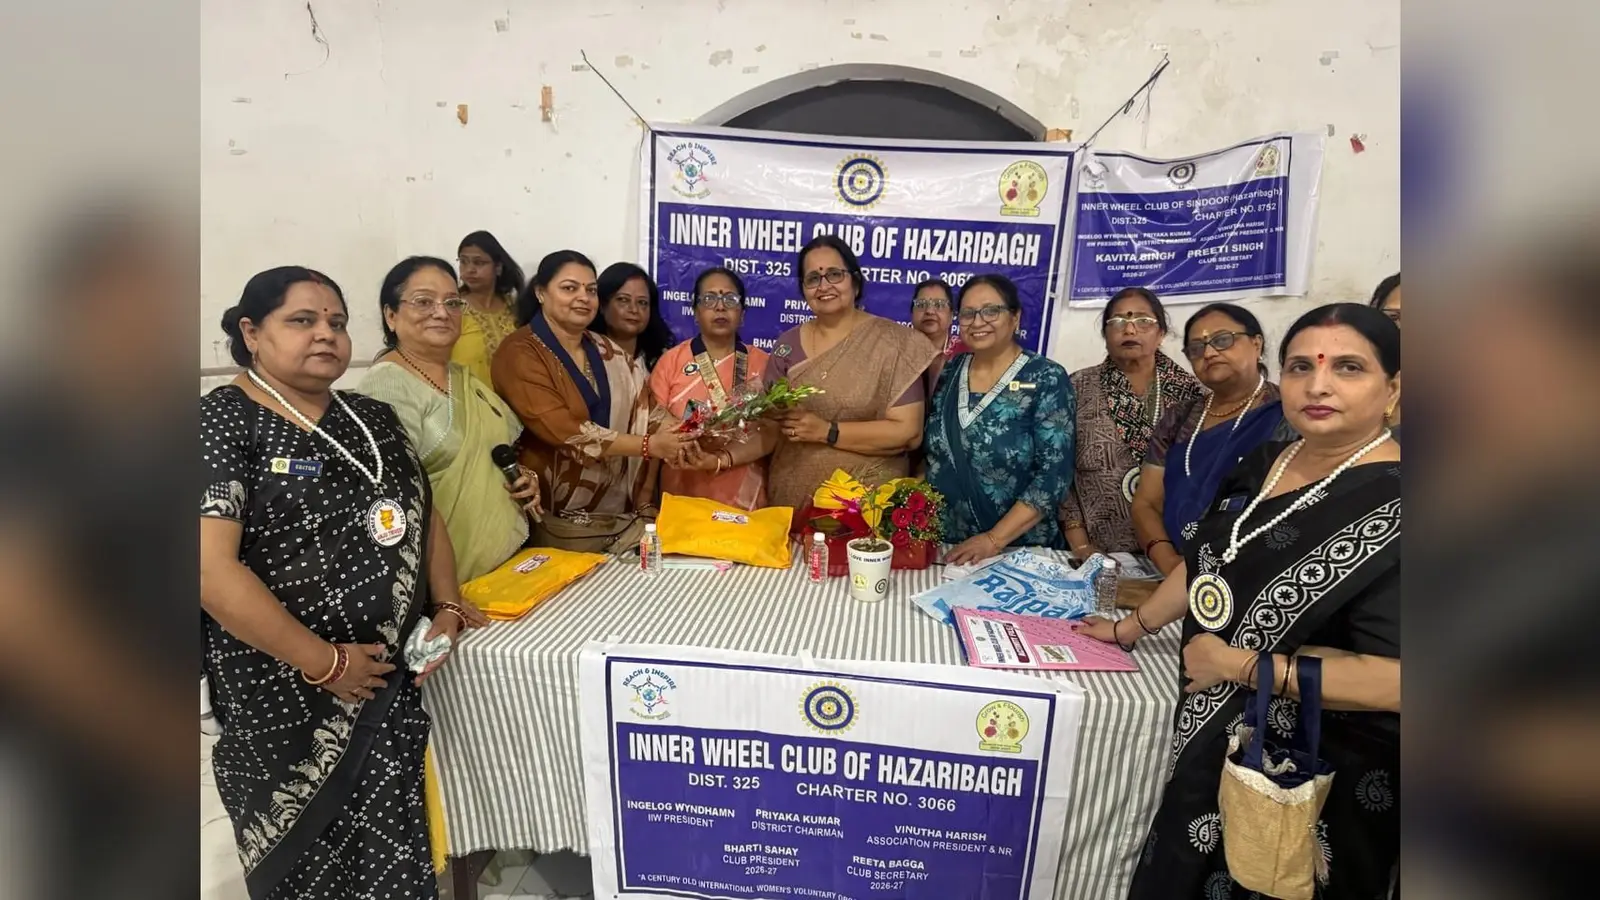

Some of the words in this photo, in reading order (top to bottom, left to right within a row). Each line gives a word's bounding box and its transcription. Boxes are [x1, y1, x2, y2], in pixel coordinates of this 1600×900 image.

[1081, 203, 1109, 211] INNER
[1110, 203, 1142, 211] WHEEL
[1145, 202, 1170, 211] CLUB
[1172, 201, 1184, 210] OF
[1241, 205, 1257, 214] NO.
[669, 213, 732, 249] INNER
[738, 217, 804, 253] WHEEL
[871, 226, 899, 260] OF
[903, 228, 1042, 267] HAZARIBAGH
[1096, 254, 1137, 263] KAVITA
[1187, 246, 1229, 259] PREETI
[1231, 242, 1264, 253] SINGH
[724, 258, 761, 274] DIST.
[766, 261, 792, 277] 325
[860, 267, 902, 284] RTER
[663, 290, 695, 302] INGEL
[753, 338, 777, 349] BHA
[623, 669, 644, 687] REACH
[652, 668, 677, 690] INSPIRE
[629, 732, 695, 765] INNER
[701, 737, 775, 770] WHEEL
[781, 744, 837, 776] CLUB
[843, 750, 872, 781] OF
[878, 754, 1024, 797] HAZARIBAGH
[689, 773, 728, 789] DIST.
[733, 776, 761, 790] 325
[796, 783, 878, 804] CHARTER
[883, 792, 912, 806] NO.
[918, 797, 957, 812] 3066
[627, 801, 673, 811] INGELOG
[675, 803, 736, 818] WYNDHAMN
[648, 814, 662, 823] IIW
[664, 815, 715, 828] PRESIDENT
[756, 809, 800, 822] PRIYAKA
[803, 815, 841, 827] KUMAR
[752, 821, 793, 834] DISTRICT
[795, 825, 844, 839] CHAIRMAN
[895, 825, 943, 839] VINUTHA
[946, 831, 987, 842] HARISH
[724, 844, 762, 854] BHARTI
[765, 846, 799, 857] SAHAY
[867, 836, 931, 849] ASSOCIATION
[933, 841, 987, 853] PRESIDENT
[989, 846, 996, 854] &
[998, 847, 1013, 856] NR
[723, 855, 748, 865] CLUB
[750, 855, 801, 868] PRESIDENT
[853, 856, 886, 869] REETA
[889, 859, 925, 870] BAGGA
[745, 867, 778, 876] 2026-27
[847, 866, 872, 879] CLUB
[874, 870, 929, 882] SECRETARY
[648, 874, 681, 884] CENTURY
[683, 877, 697, 886] OLD
[698, 880, 755, 893] INTERNATIONAL
[756, 885, 792, 895] WOMEN'S
[793, 887, 837, 900] VOLUNTARY
[870, 881, 904, 890] 2026-27
